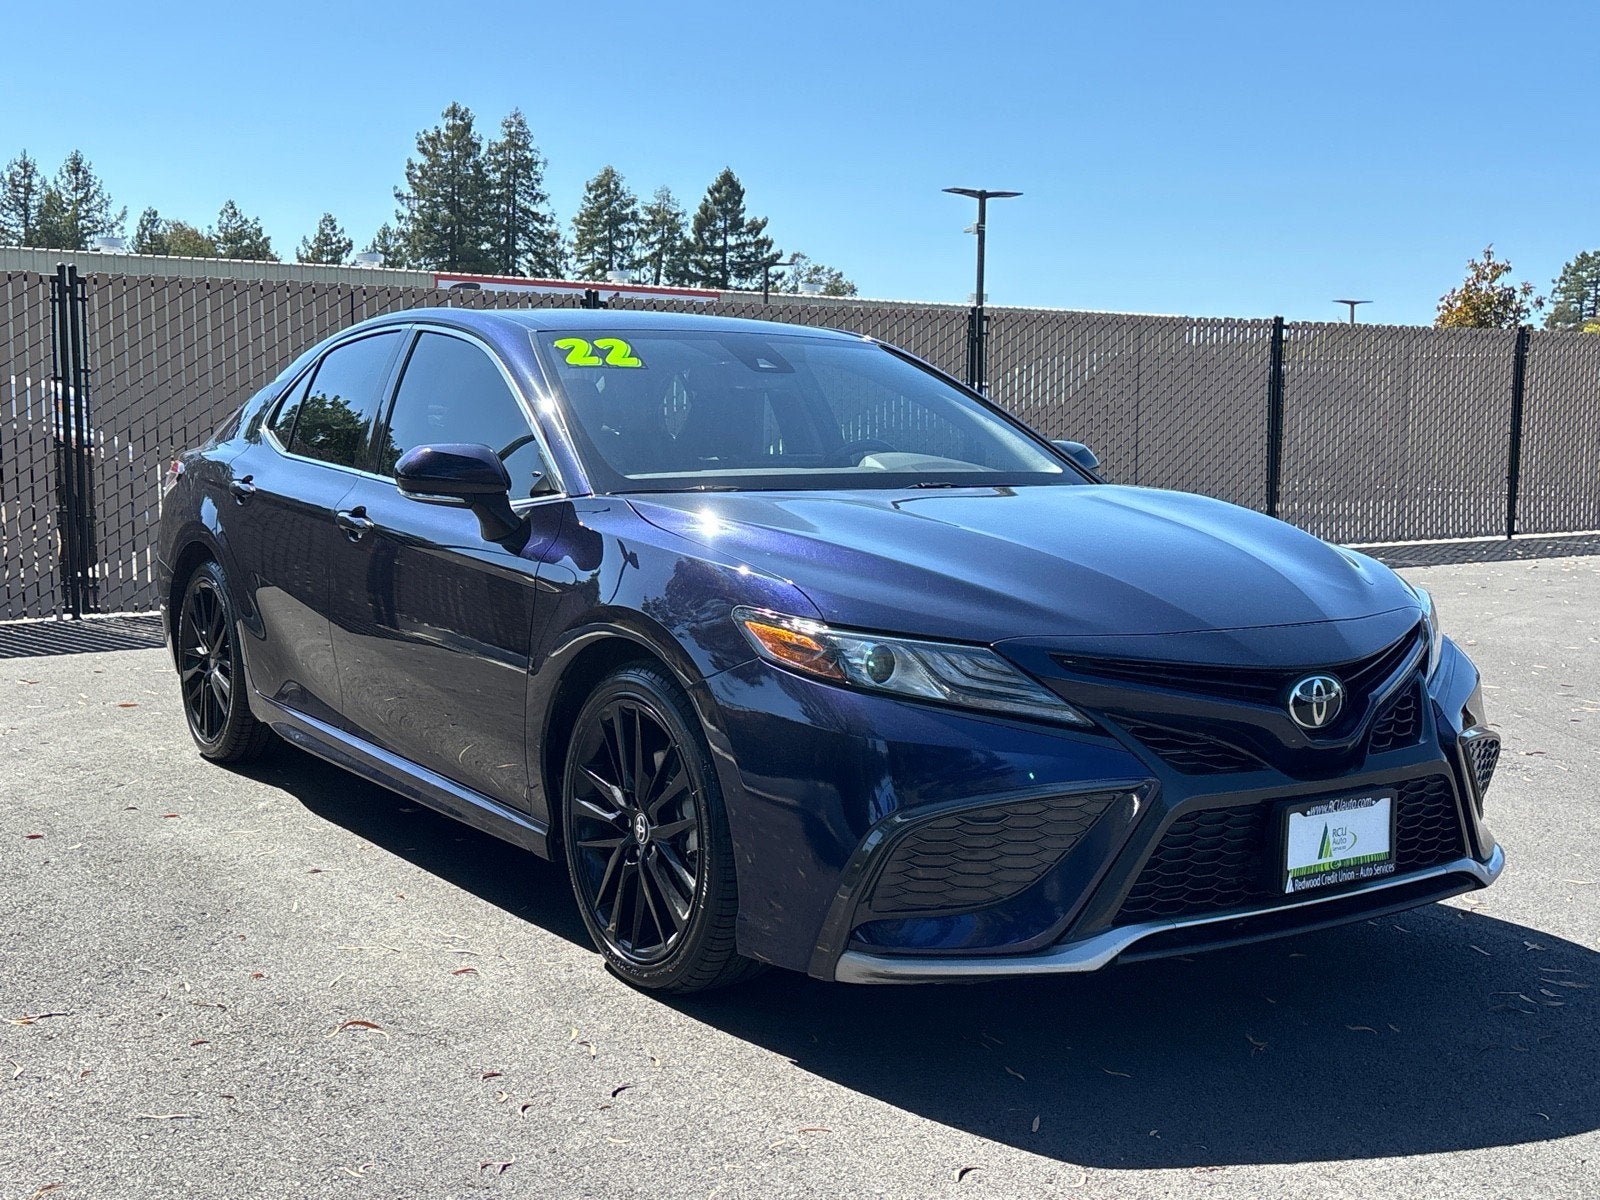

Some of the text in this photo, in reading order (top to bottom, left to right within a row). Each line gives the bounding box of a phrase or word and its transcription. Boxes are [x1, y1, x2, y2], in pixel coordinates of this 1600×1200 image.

[554, 338, 642, 367] 22
[1310, 797, 1372, 816] www.RCUauto.com
[1332, 827, 1347, 837] RCU
[1333, 836, 1347, 845] Auto
[1294, 877, 1320, 890] Redwood
[1321, 872, 1337, 885] Credit
[1339, 870, 1355, 882] Union
[1360, 866, 1373, 878] Auto
[1373, 862, 1395, 875] Services
